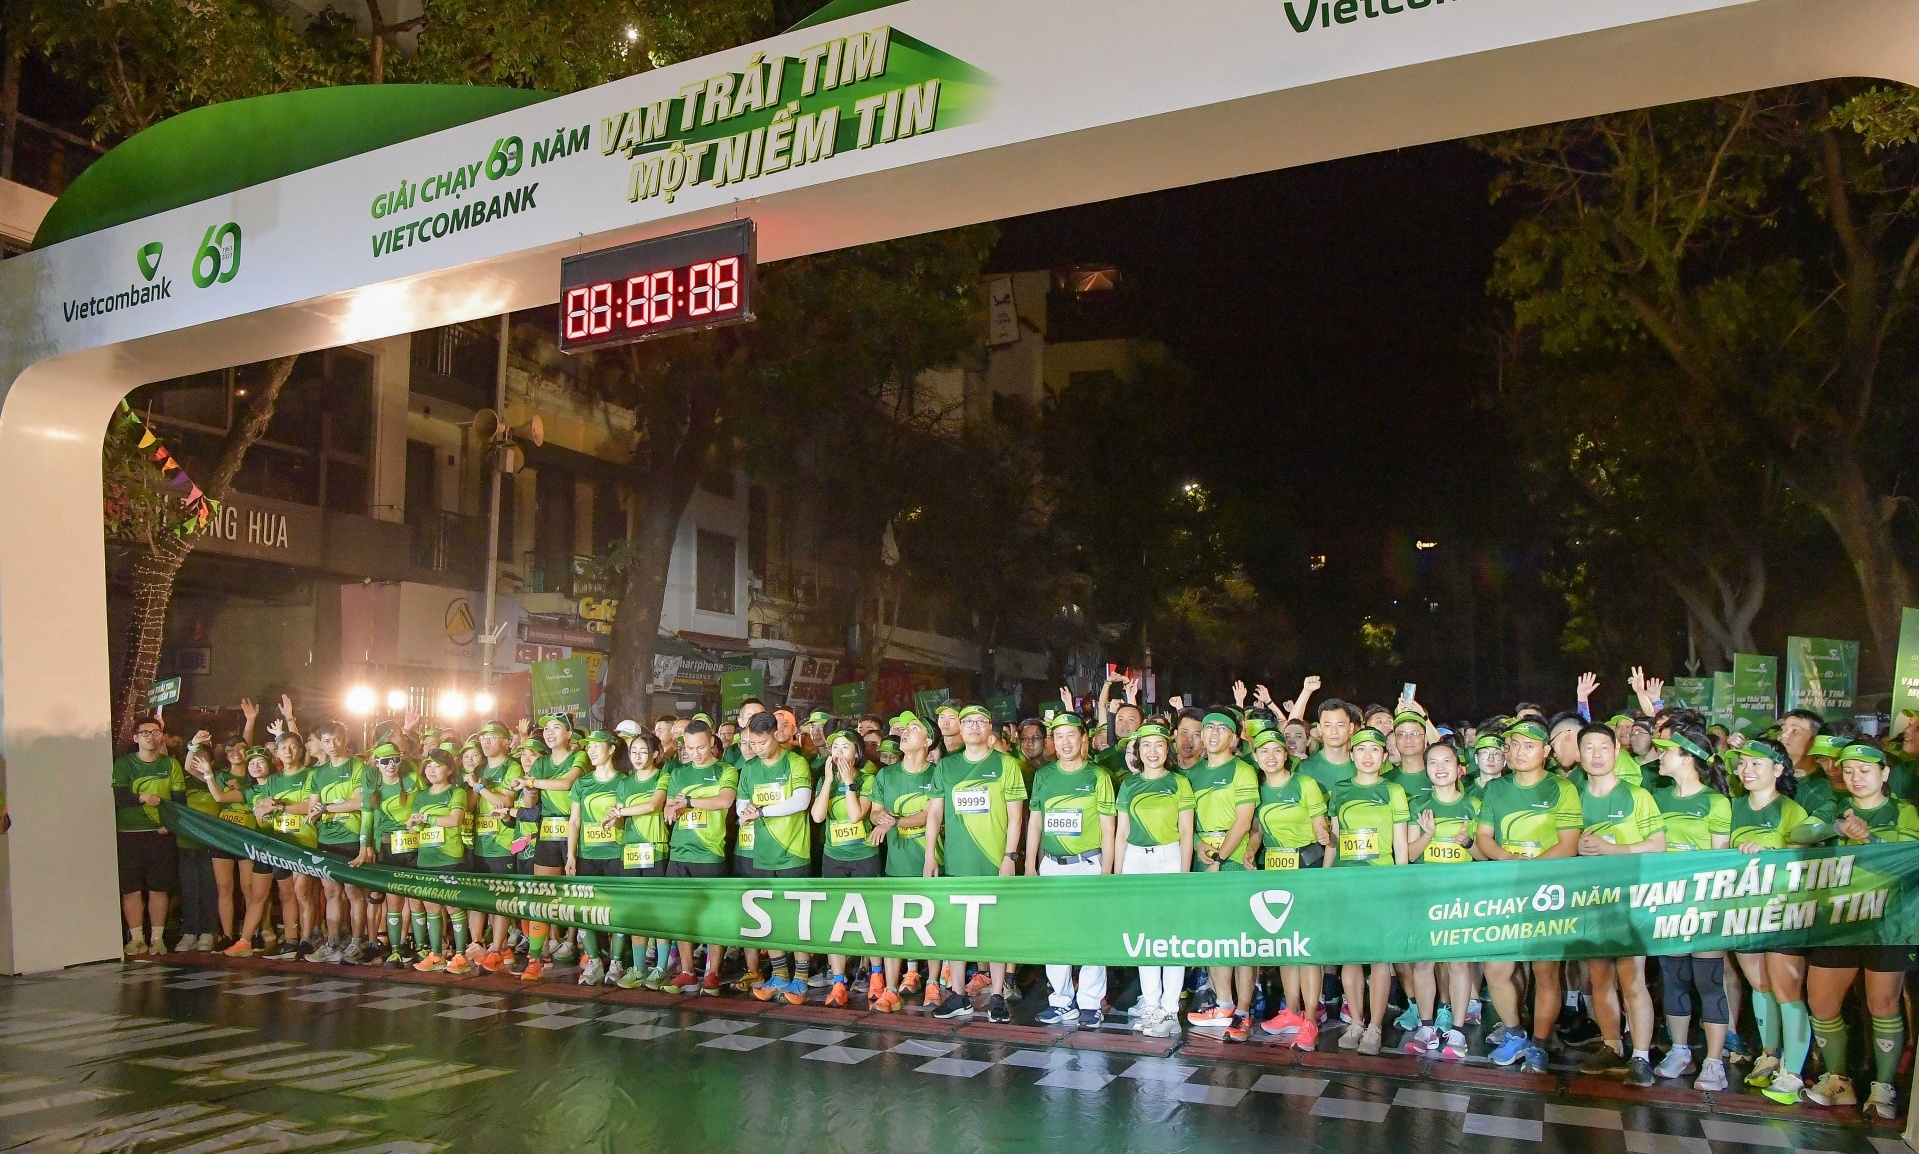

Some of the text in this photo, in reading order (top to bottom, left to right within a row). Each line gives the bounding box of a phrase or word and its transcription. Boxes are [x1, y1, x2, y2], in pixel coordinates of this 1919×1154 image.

[600, 25, 892, 160] VẠN TRÁI TIM
[627, 78, 941, 203] MỘT NIỀM TIN
[371, 124, 591, 219] GIẢI CHẠY 60 NĂM
[371, 182, 539, 258] VIETCOMBANK
[192, 222, 242, 288] 60
[63, 276, 172, 323] Vietcombank
[209, 505, 288, 548] NG HUA
[756, 791, 782, 803] 10069
[957, 796, 986, 806] 99999
[741, 833, 754, 843] 100
[834, 825, 859, 838] 10517
[1047, 818, 1079, 829] 68686
[1343, 838, 1374, 851] 10124
[1429, 846, 1461, 859] 10136
[243, 842, 335, 881] Vietcombank
[1267, 857, 1295, 868] 10009
[387, 882, 461, 901] VIETCOMBANK
[1629, 854, 1856, 913] VẠN TRÁI TIM
[580, 905, 611, 926] TIN
[740, 889, 997, 948] START
[1428, 884, 1621, 921] GIẢI CHẠY 60 NĂM
[1653, 888, 1889, 942] MỘT NIỀM TIN
[1122, 931, 1312, 958] Vietcombank
[1429, 918, 1579, 947] VIETCOMBANK
